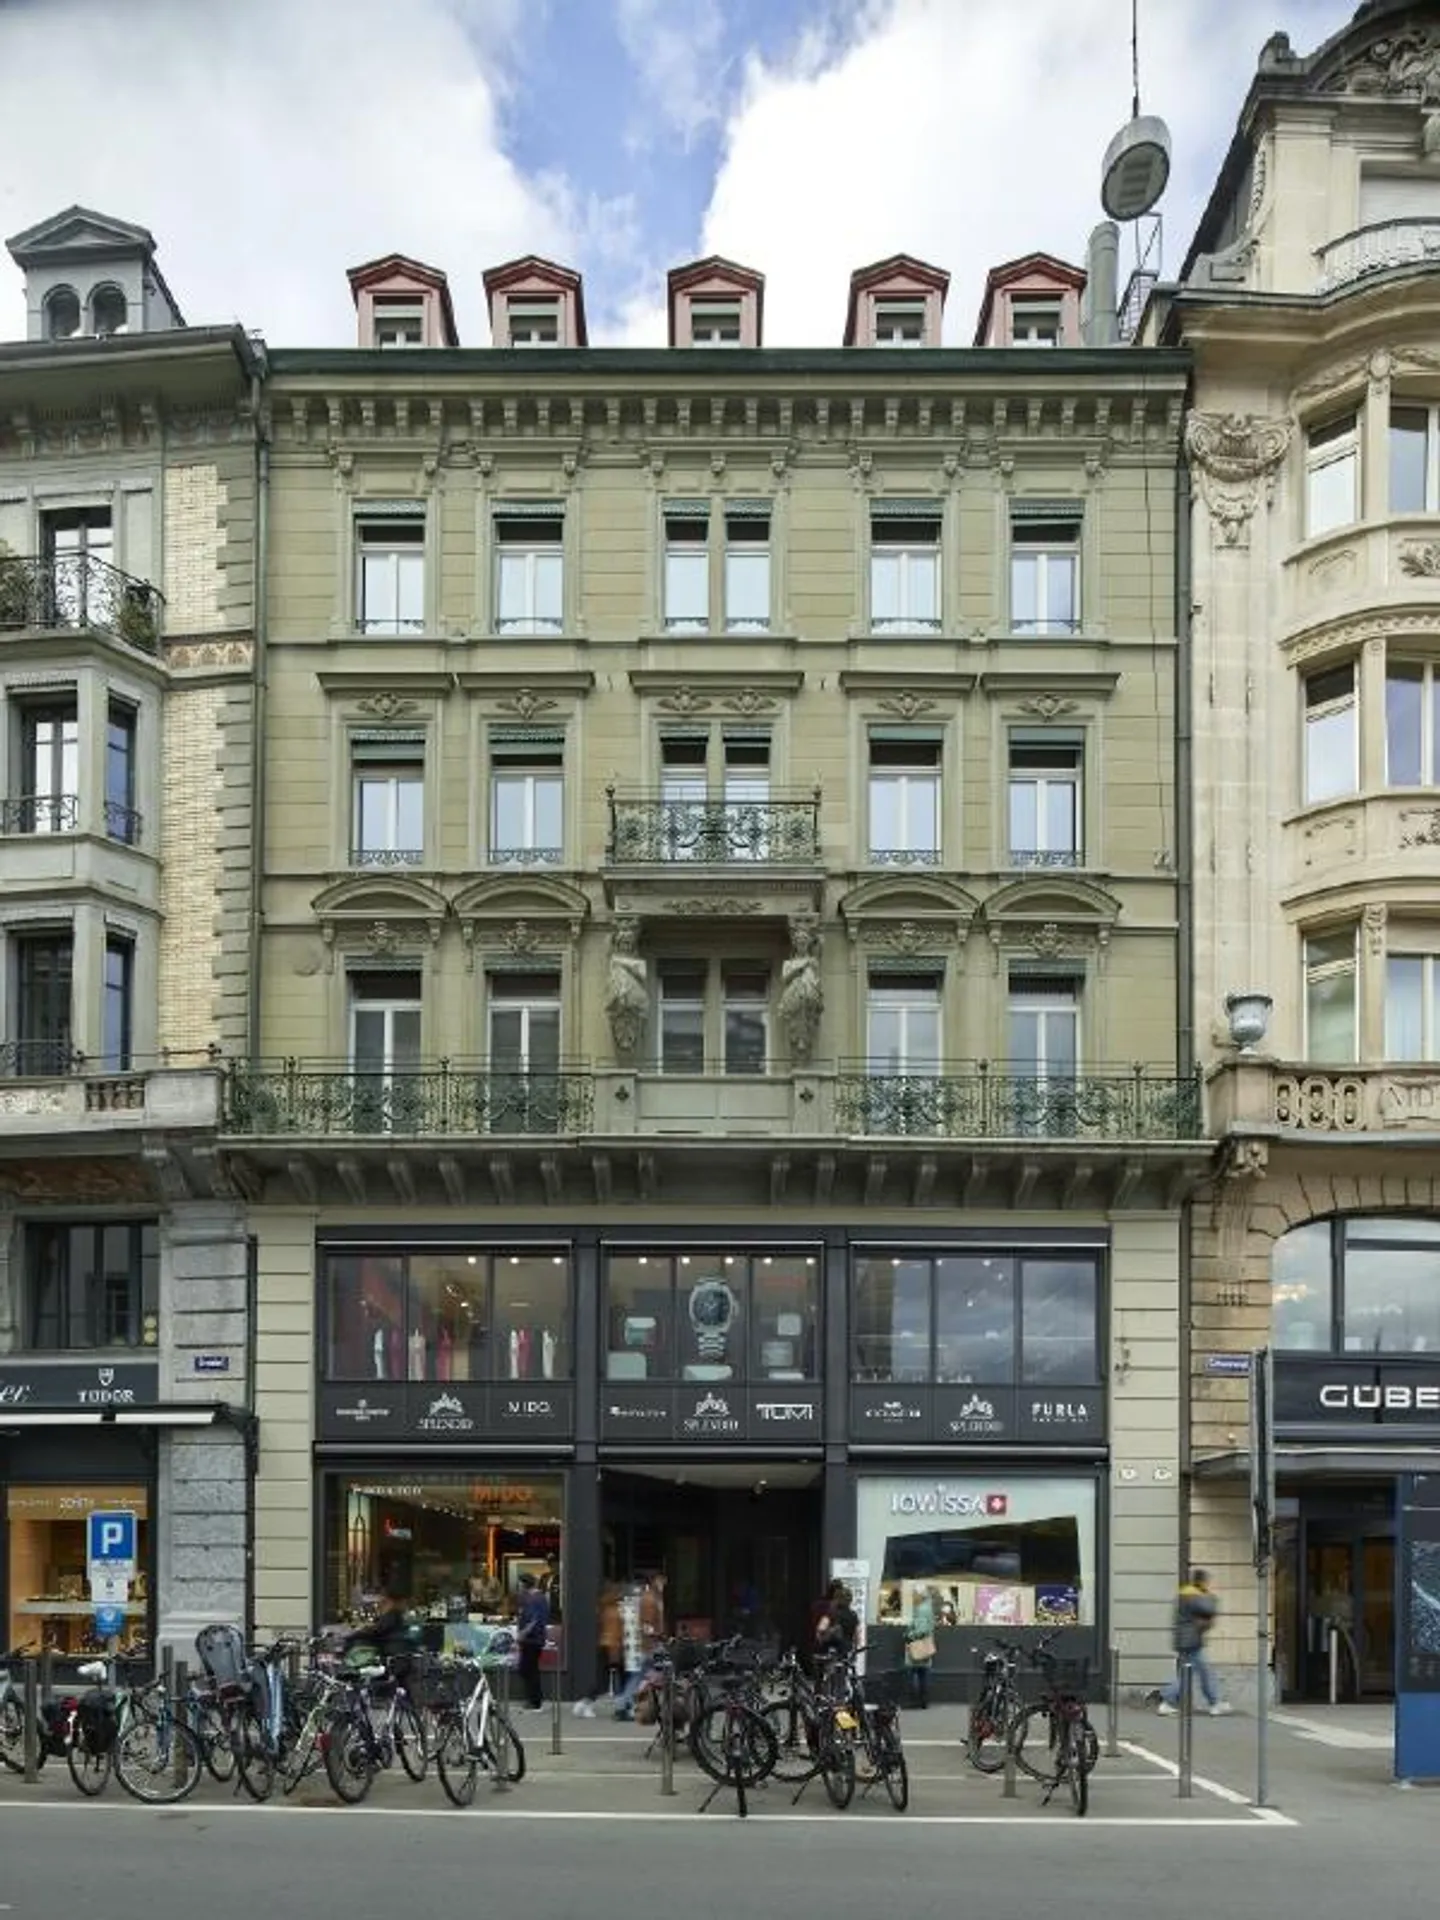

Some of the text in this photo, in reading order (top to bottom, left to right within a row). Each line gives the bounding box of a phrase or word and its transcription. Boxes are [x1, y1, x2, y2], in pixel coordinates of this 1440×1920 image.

[78, 1389, 135, 1403] TUDOR
[756, 1403, 812, 1420] TUMI
[1032, 1402, 1087, 1417] FURLA
[102, 1521, 124, 1554] P
